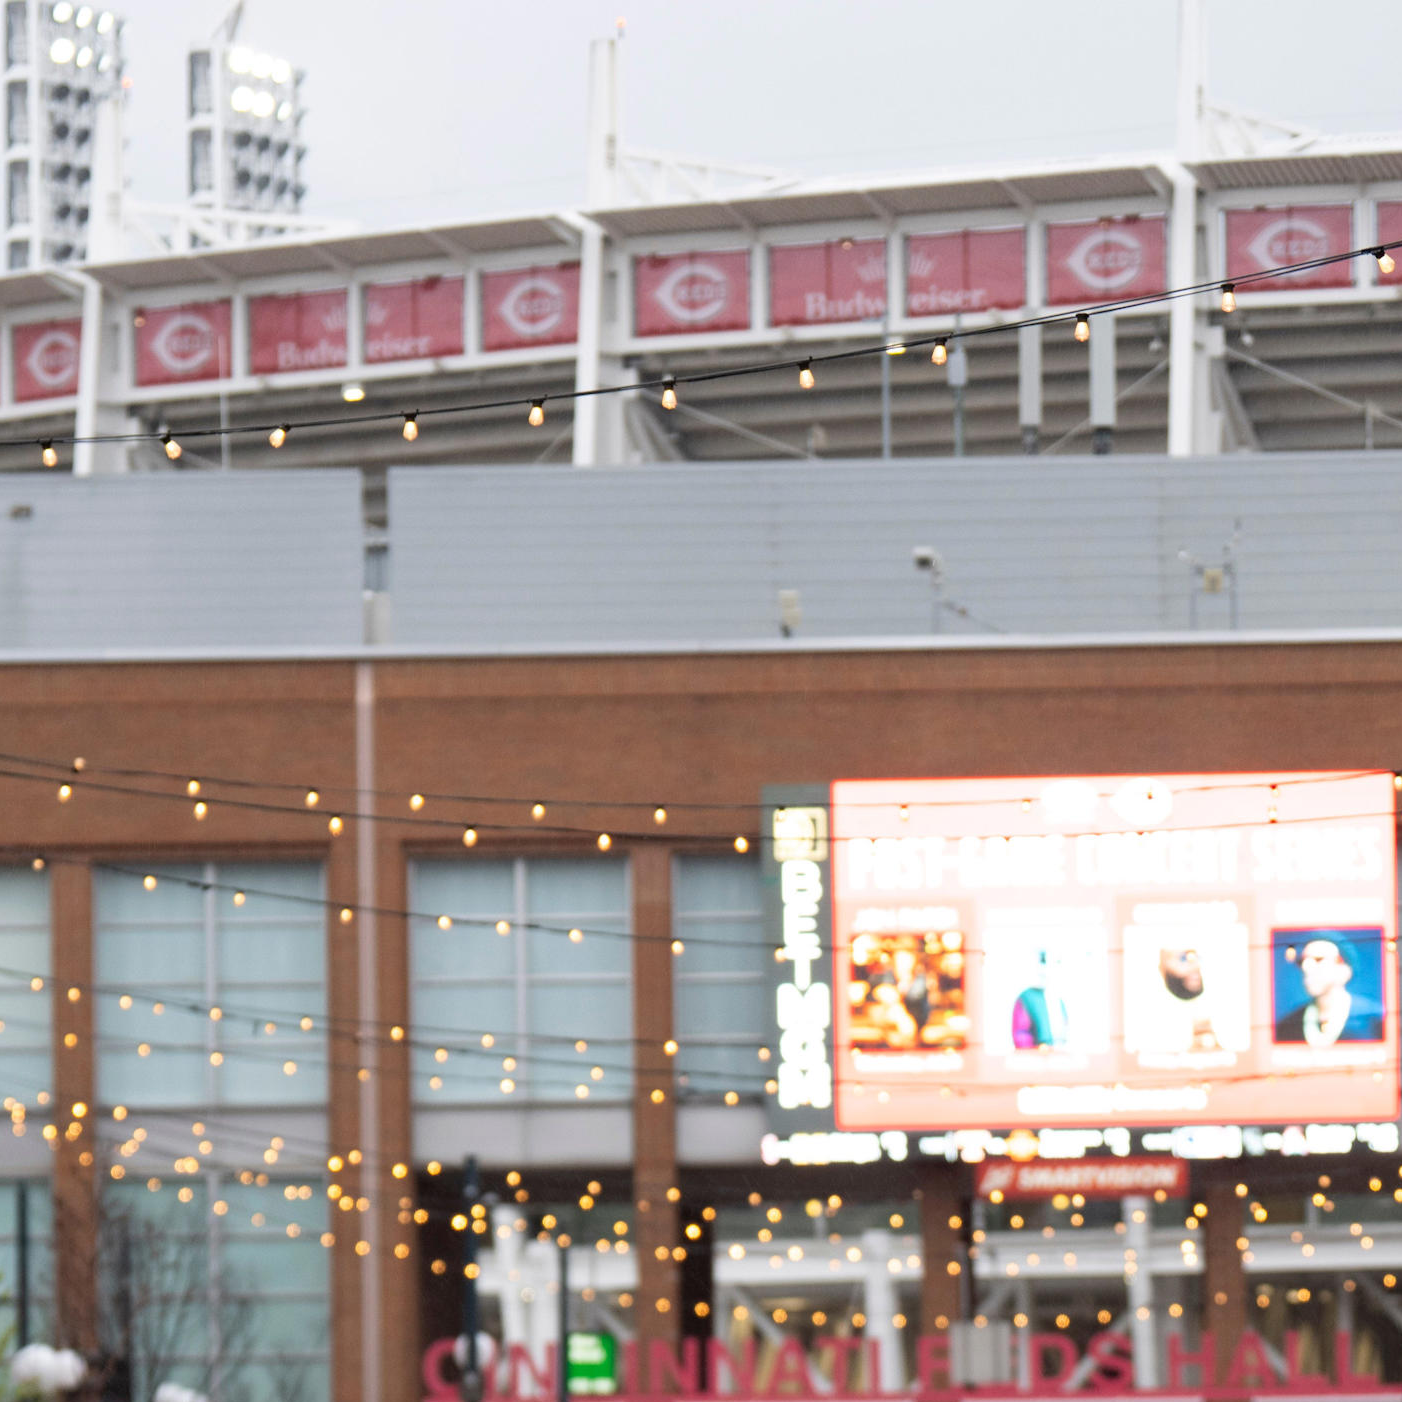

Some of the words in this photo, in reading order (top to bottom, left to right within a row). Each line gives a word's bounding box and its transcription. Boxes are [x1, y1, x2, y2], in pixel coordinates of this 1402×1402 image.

[423, 1335, 884, 1397] CININNATI
[916, 1331, 1135, 1395] RDS
[1167, 1329, 1380, 1391] HALL
